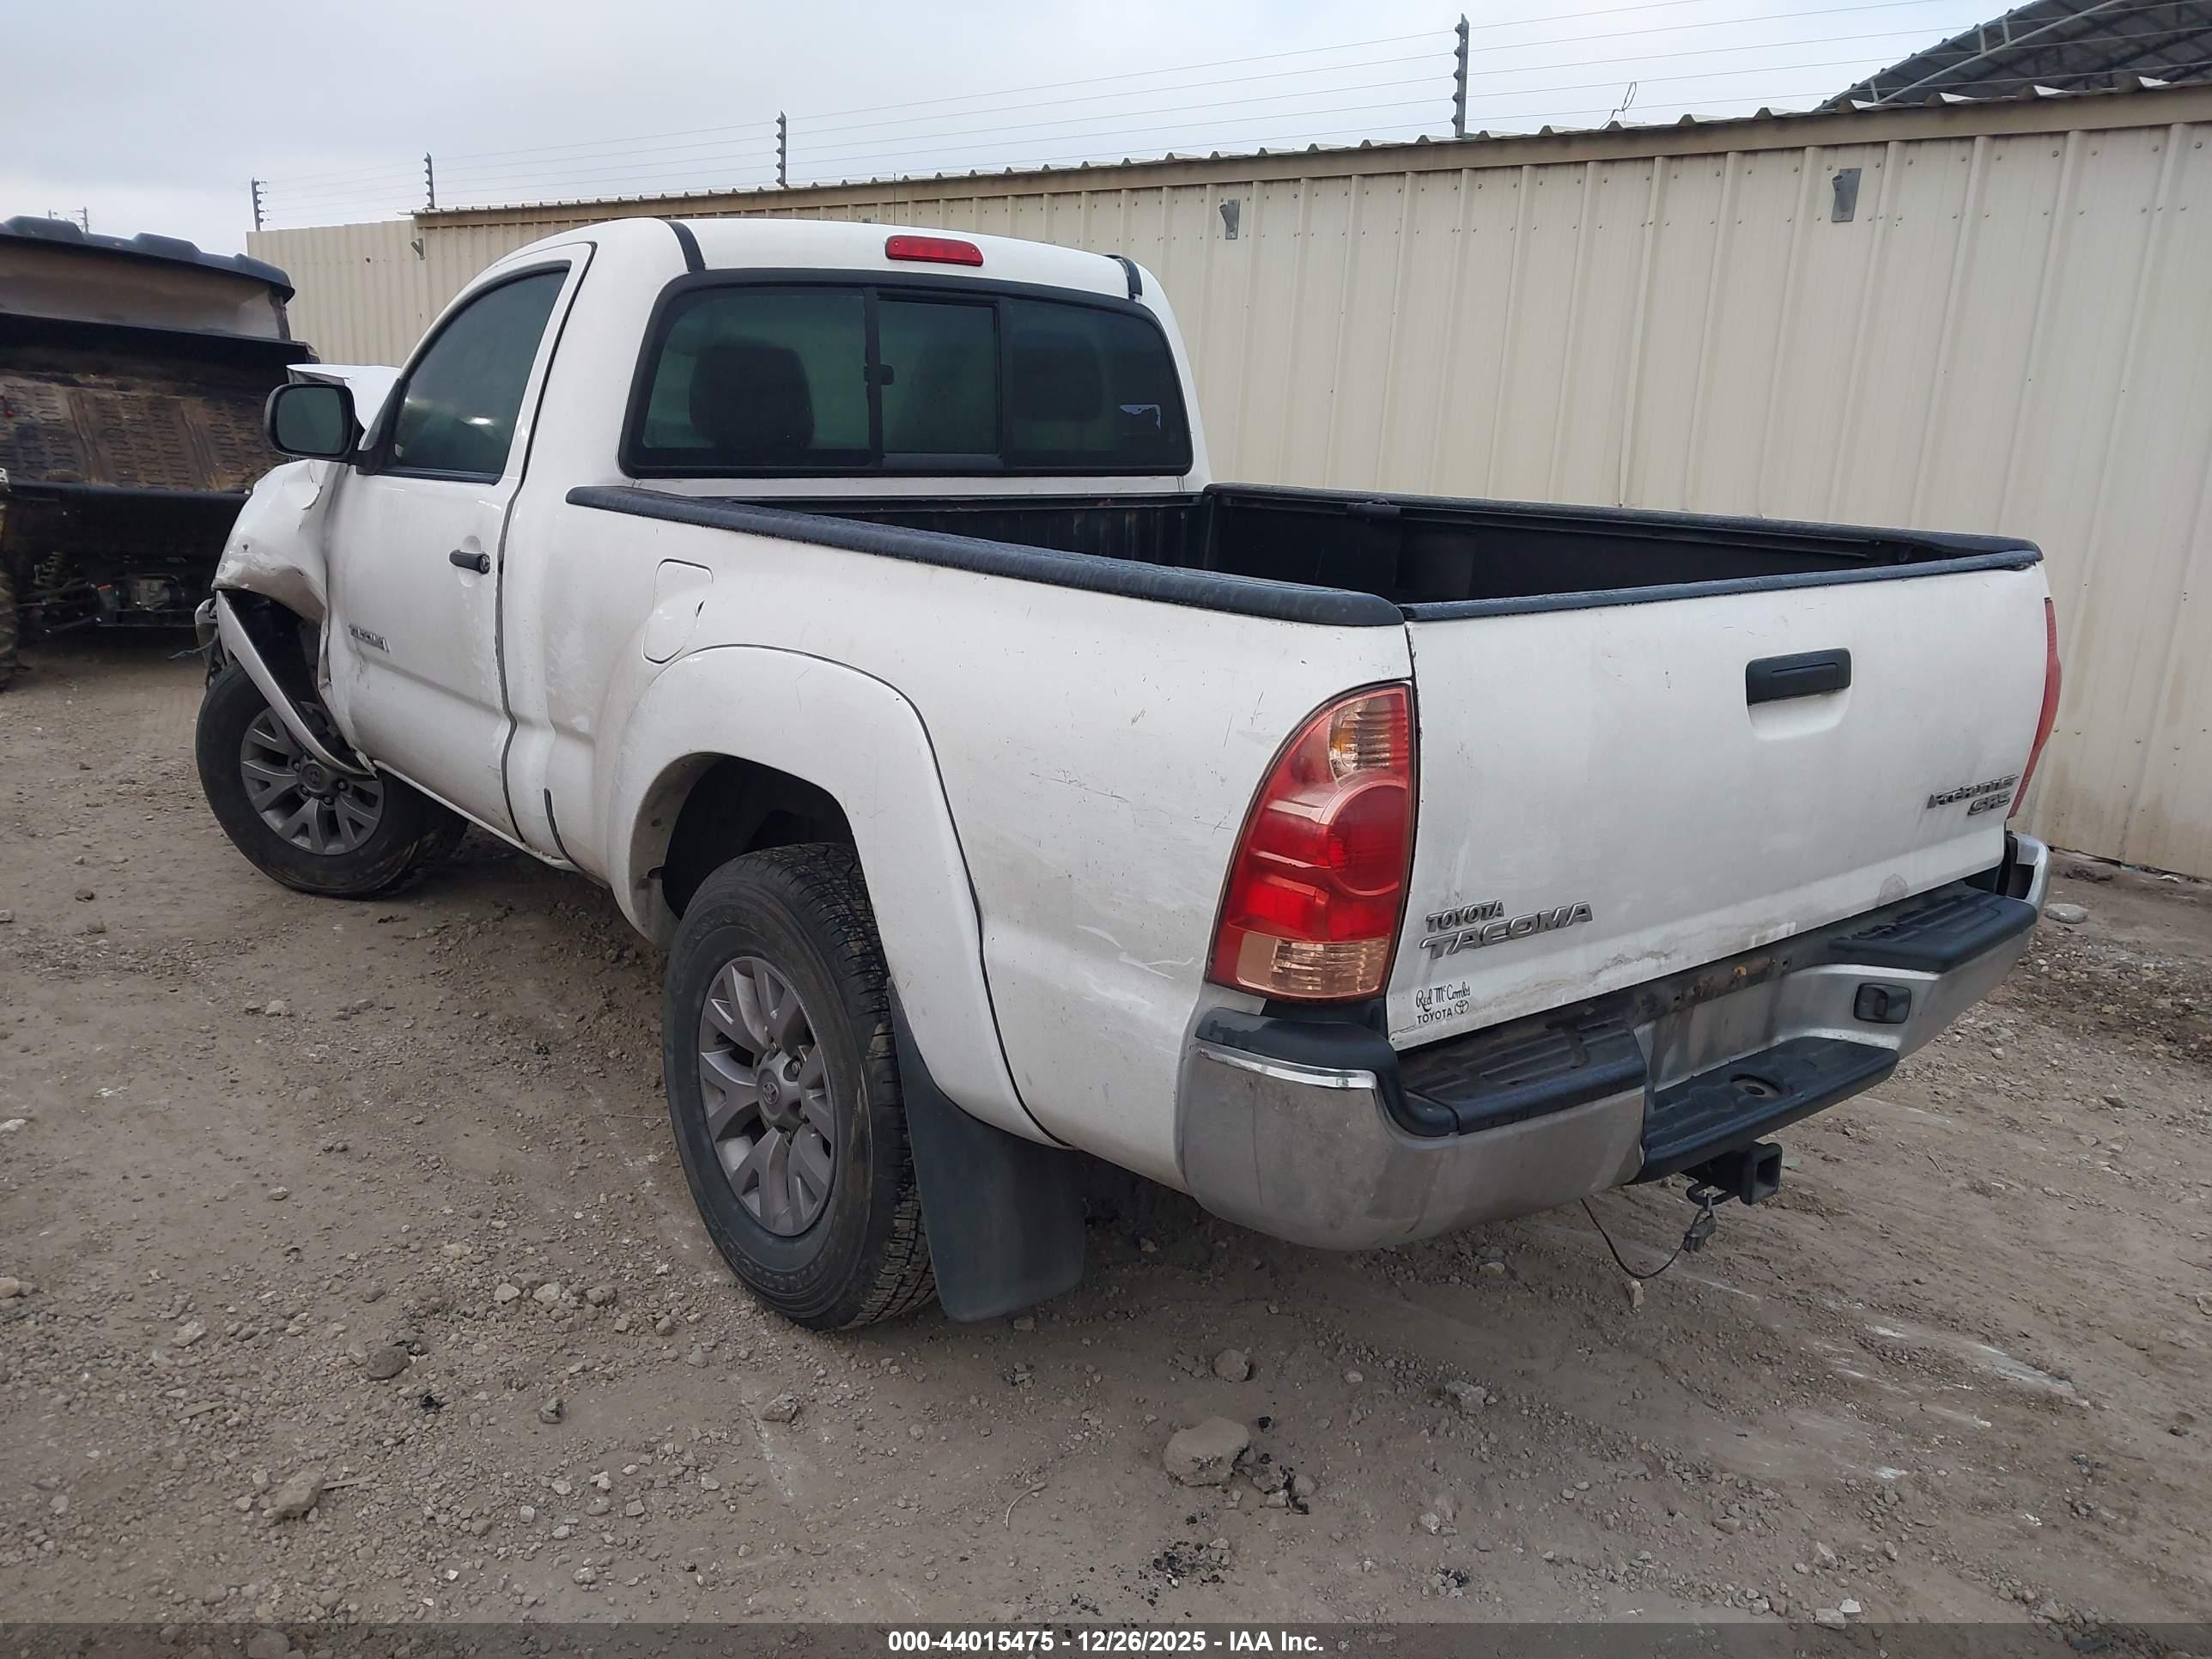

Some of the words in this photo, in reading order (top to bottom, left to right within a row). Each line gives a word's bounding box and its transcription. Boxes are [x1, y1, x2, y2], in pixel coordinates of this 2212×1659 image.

[1419, 901, 1593, 959] TACOMA
[1425, 900, 1504, 932] TOYOTA
[1416, 988, 1432, 1012] Red
[1417, 1008, 1452, 1024] TOYOTA
